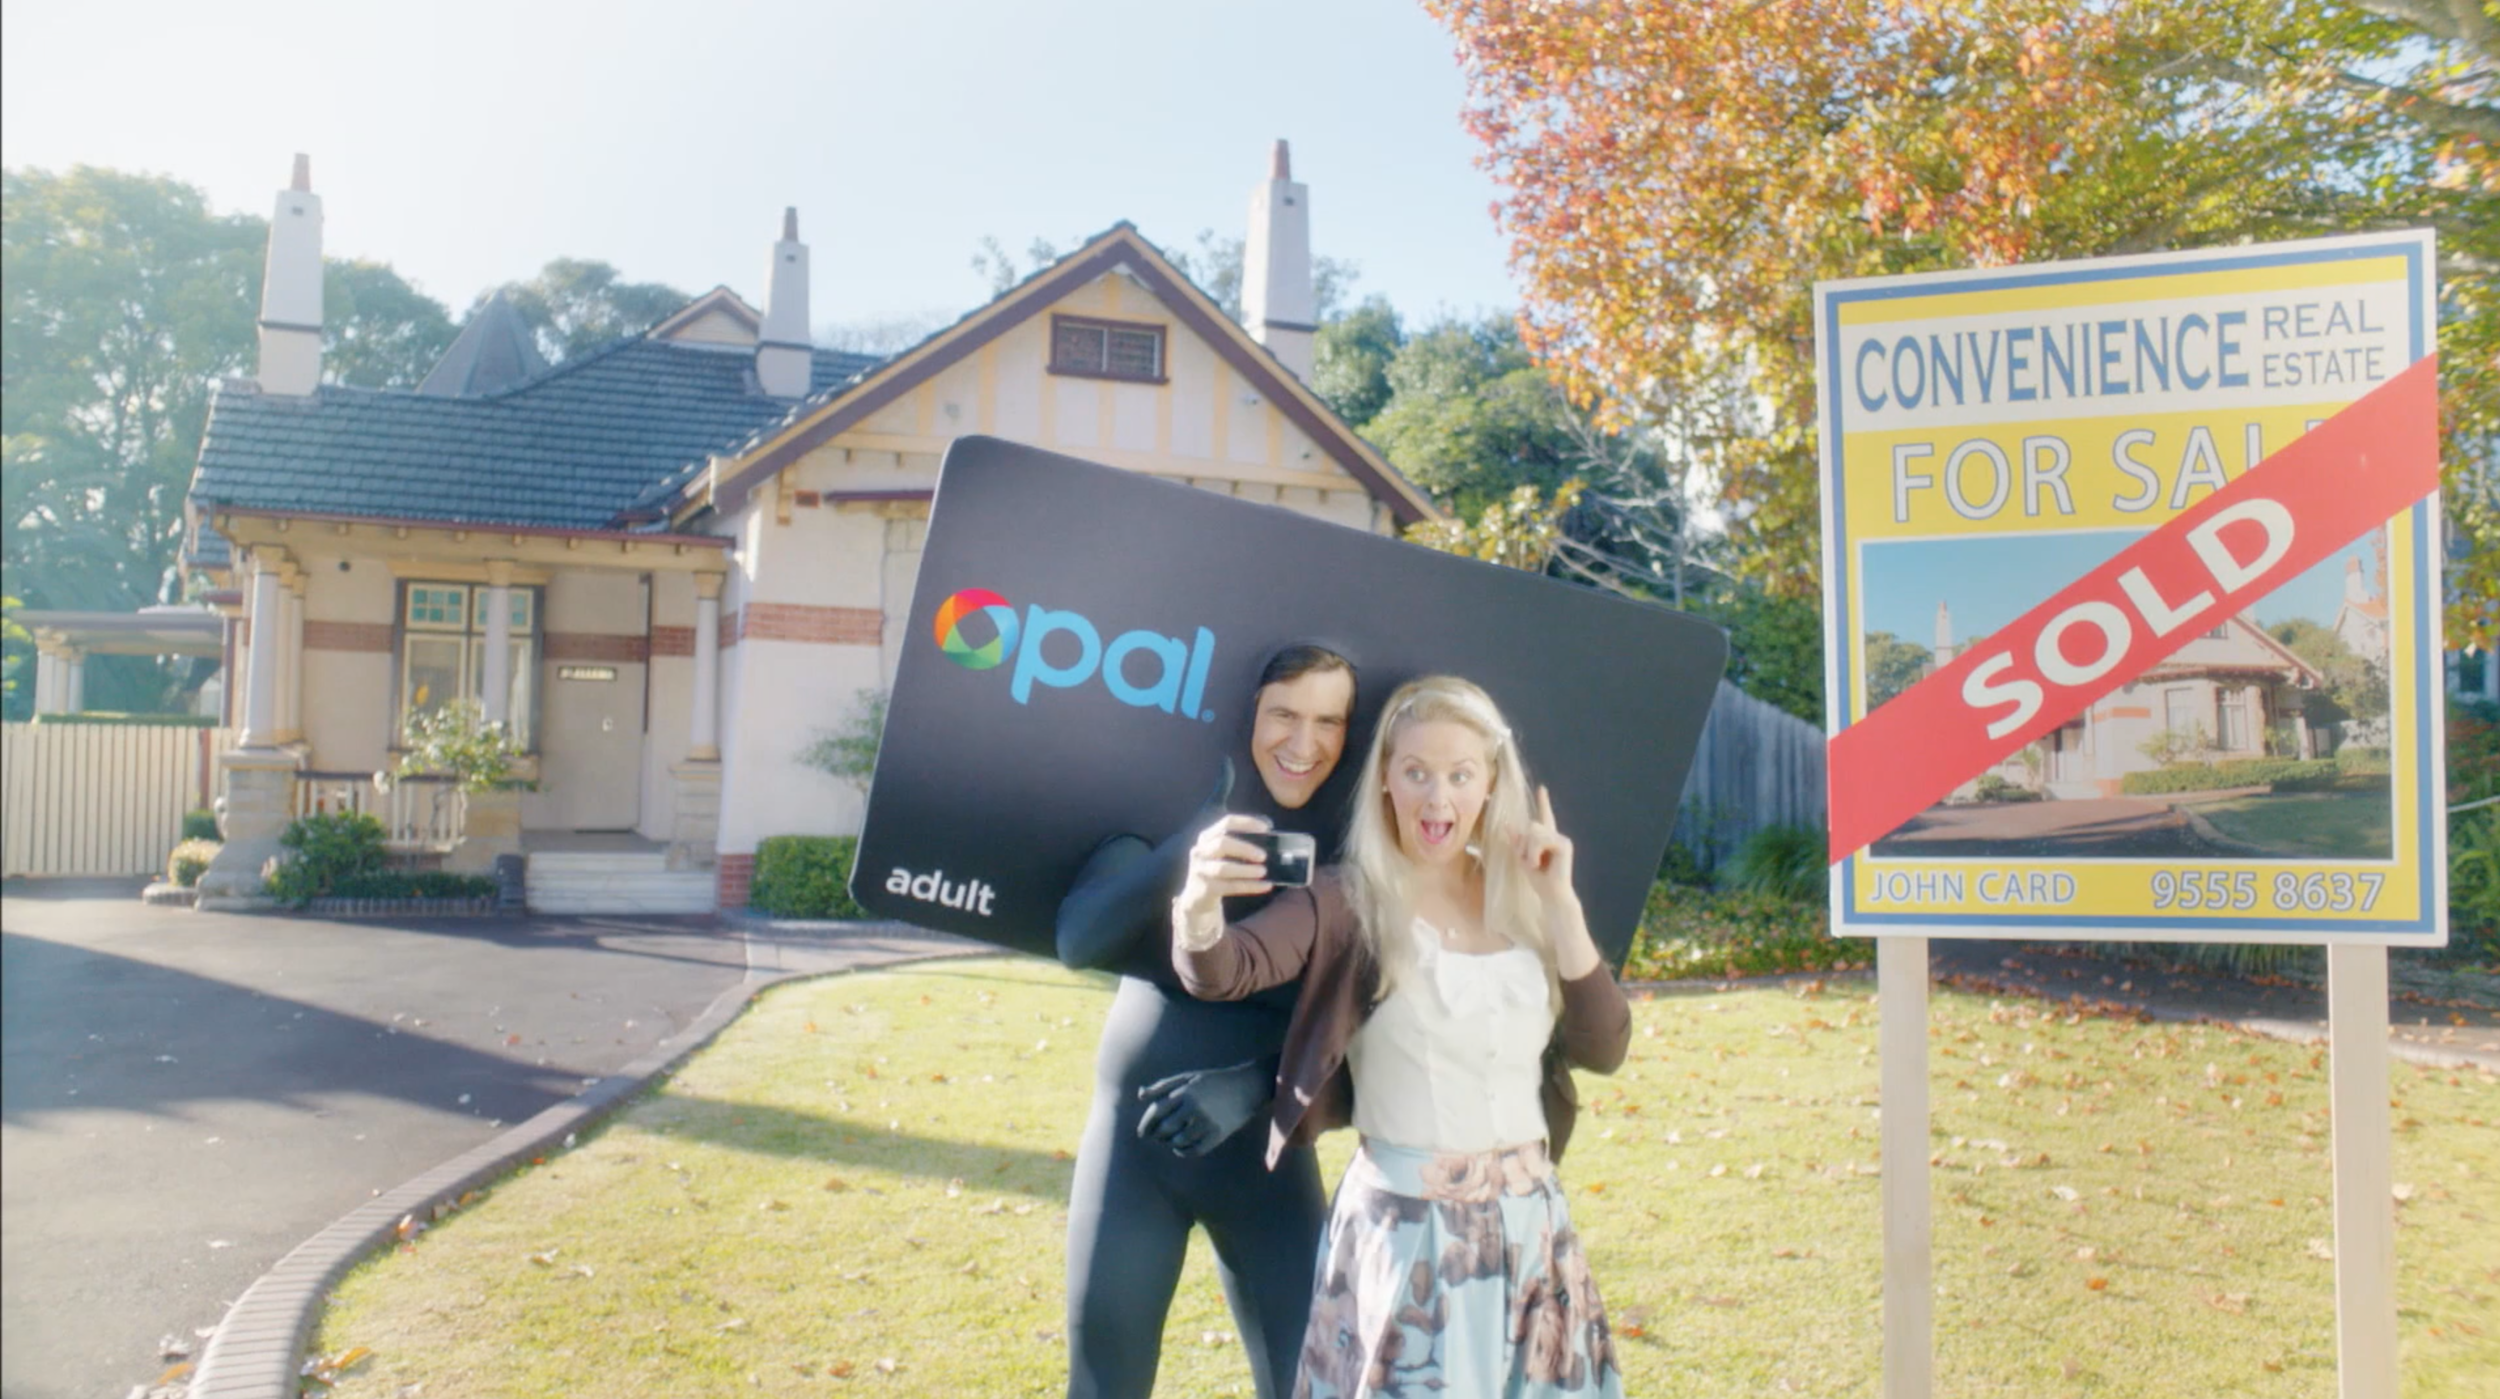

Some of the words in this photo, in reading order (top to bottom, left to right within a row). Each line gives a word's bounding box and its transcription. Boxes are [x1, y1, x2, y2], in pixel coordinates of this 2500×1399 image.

[1855, 311, 2250, 412] CONVENIENCE
[2263, 300, 2385, 340] REAL
[2263, 347, 2386, 388] ESTATE
[1892, 435, 2076, 524] FOR
[1962, 498, 2296, 740] SOLD
[885, 867, 996, 917] adult
[1869, 872, 1963, 903] JOHN
[1978, 873, 2077, 905] CARD
[2151, 871, 2257, 909] 9555
[2273, 871, 2386, 911] 8637
